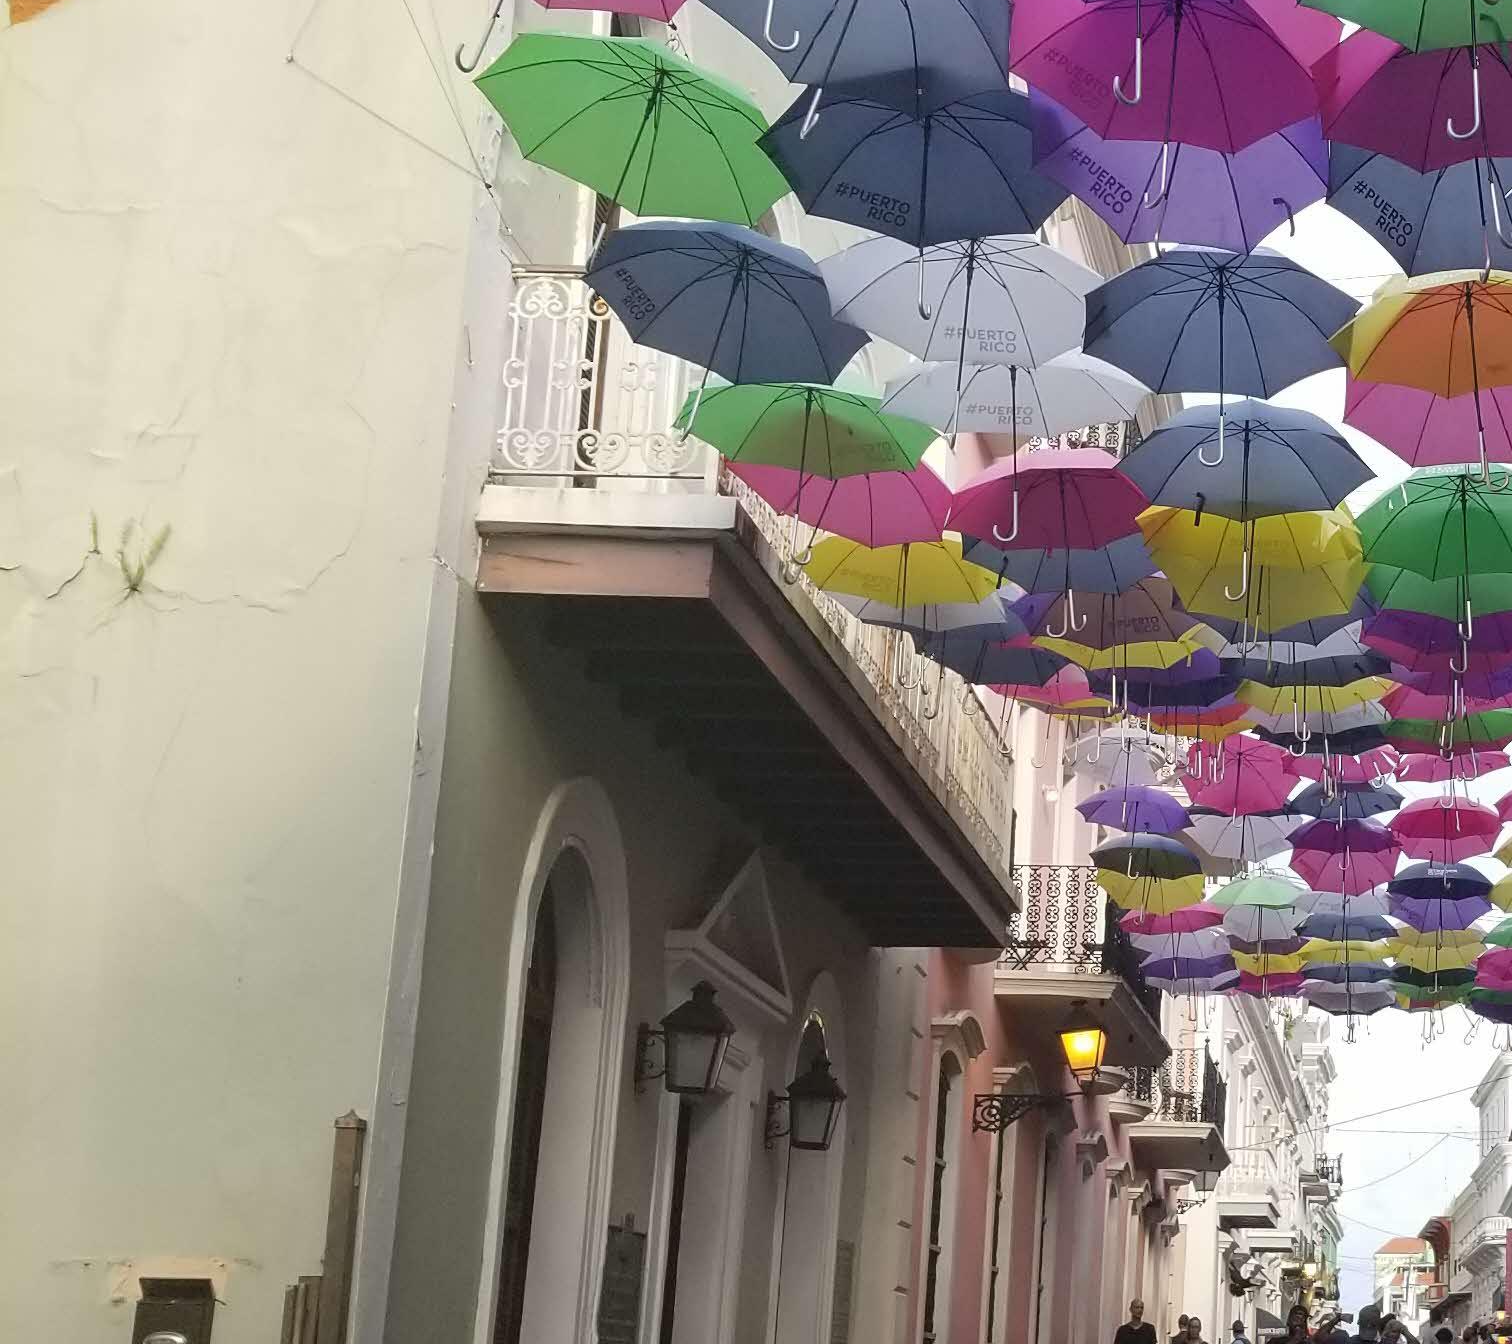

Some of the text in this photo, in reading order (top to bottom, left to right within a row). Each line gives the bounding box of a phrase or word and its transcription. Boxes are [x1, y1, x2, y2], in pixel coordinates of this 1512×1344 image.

[1071, 146, 1132, 204] #PUERTO
[836, 181, 910, 215] #PUERTO
[1090, 178, 1124, 215] RICO
[1353, 179, 1413, 236] #PUERTO
[867, 206, 906, 227] RICO
[1375, 217, 1406, 248] RICO
[616, 267, 656, 314] #PUERTO
[623, 294, 644, 321] RICO
[943, 327, 1017, 342] #PUERTO
[980, 340, 1017, 354] RICO
[965, 402, 1033, 416] #PUERTO
[998, 415, 1033, 426] RICO
